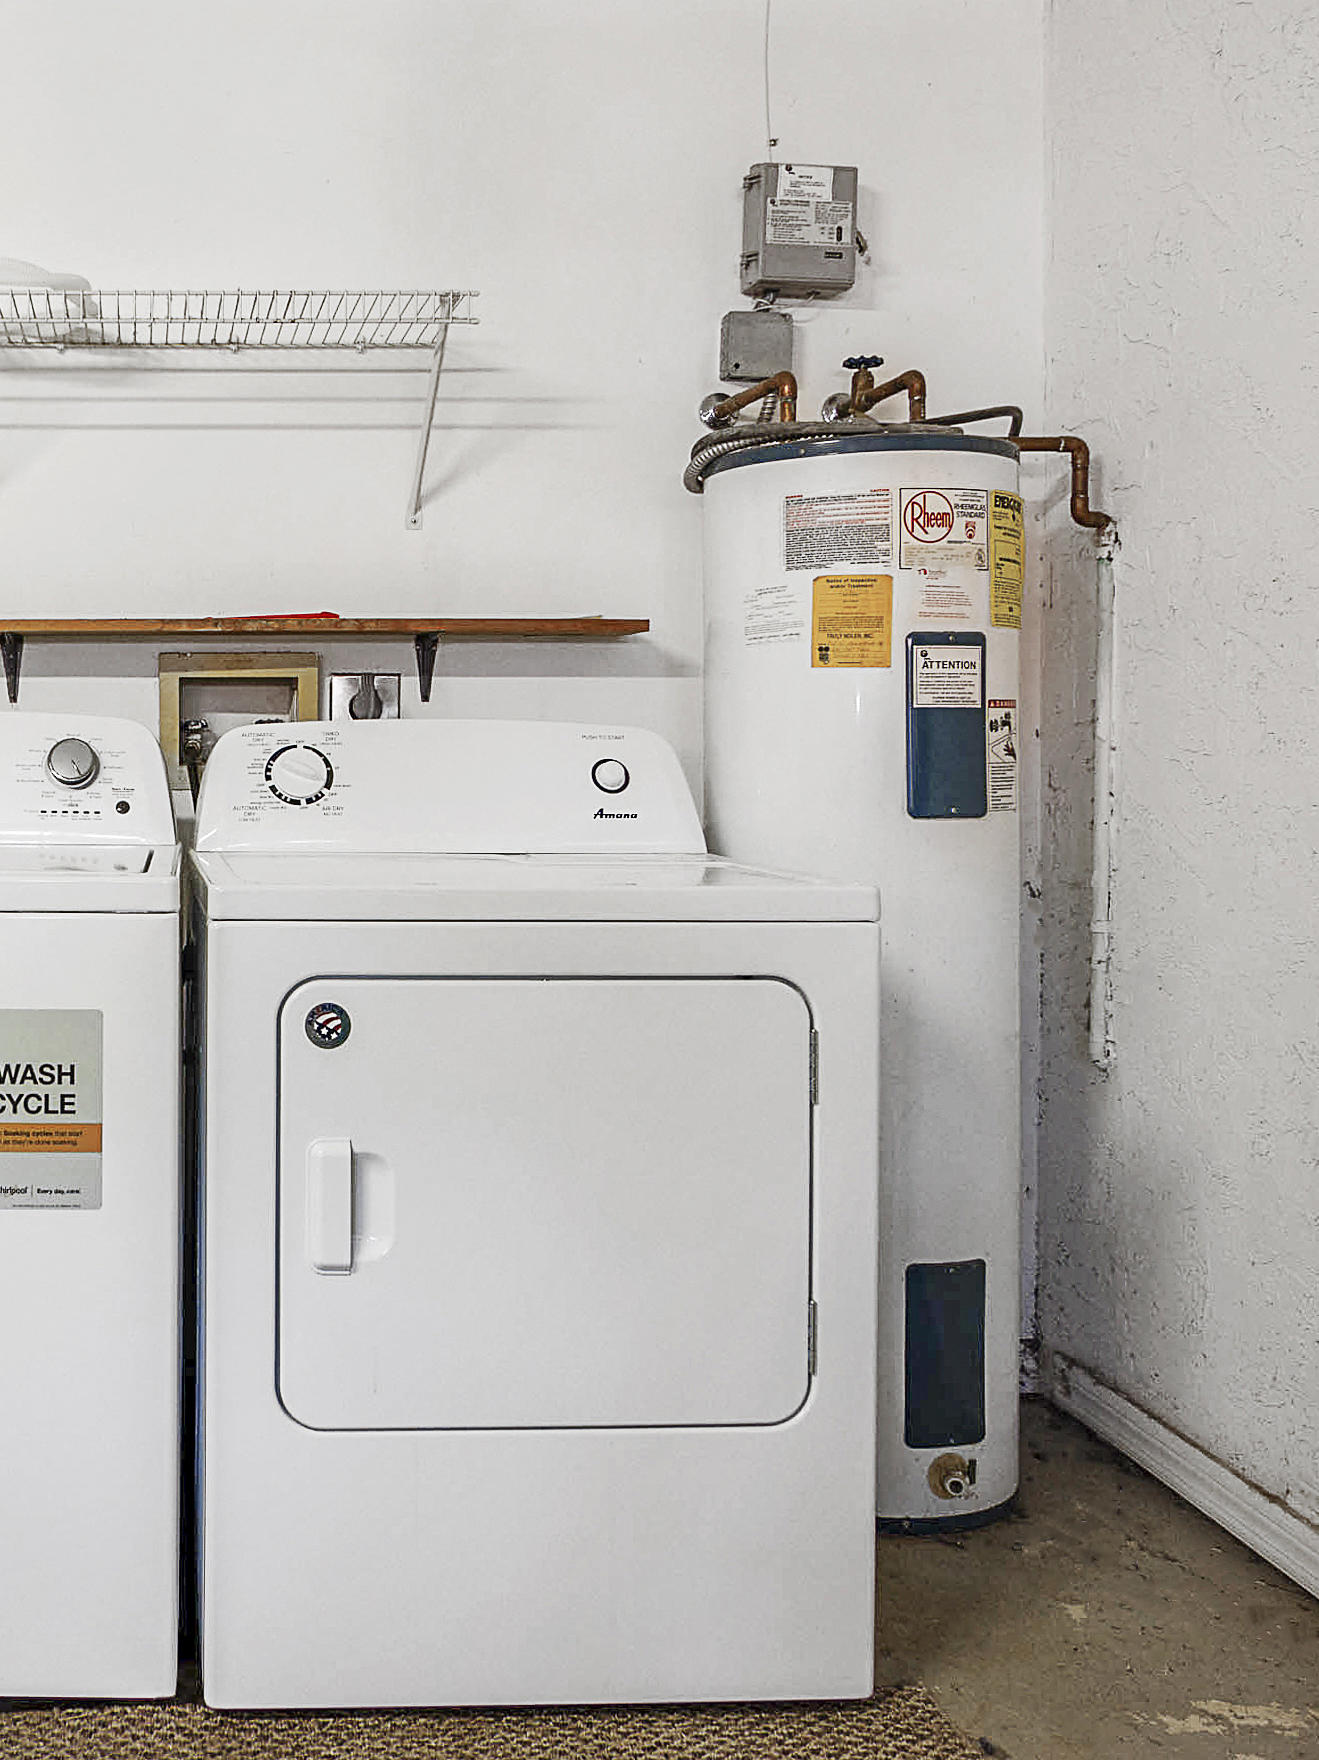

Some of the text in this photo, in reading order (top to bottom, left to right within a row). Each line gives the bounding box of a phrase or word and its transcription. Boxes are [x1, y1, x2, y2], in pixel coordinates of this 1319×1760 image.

[911, 494, 951, 535] Rheem
[956, 511, 986, 519] STANDARD
[922, 660, 977, 670] ATTENTION
[593, 807, 638, 820] Amana
[3, 1129, 30, 1138] Soaking
[31, 1129, 53, 1138] cycles
